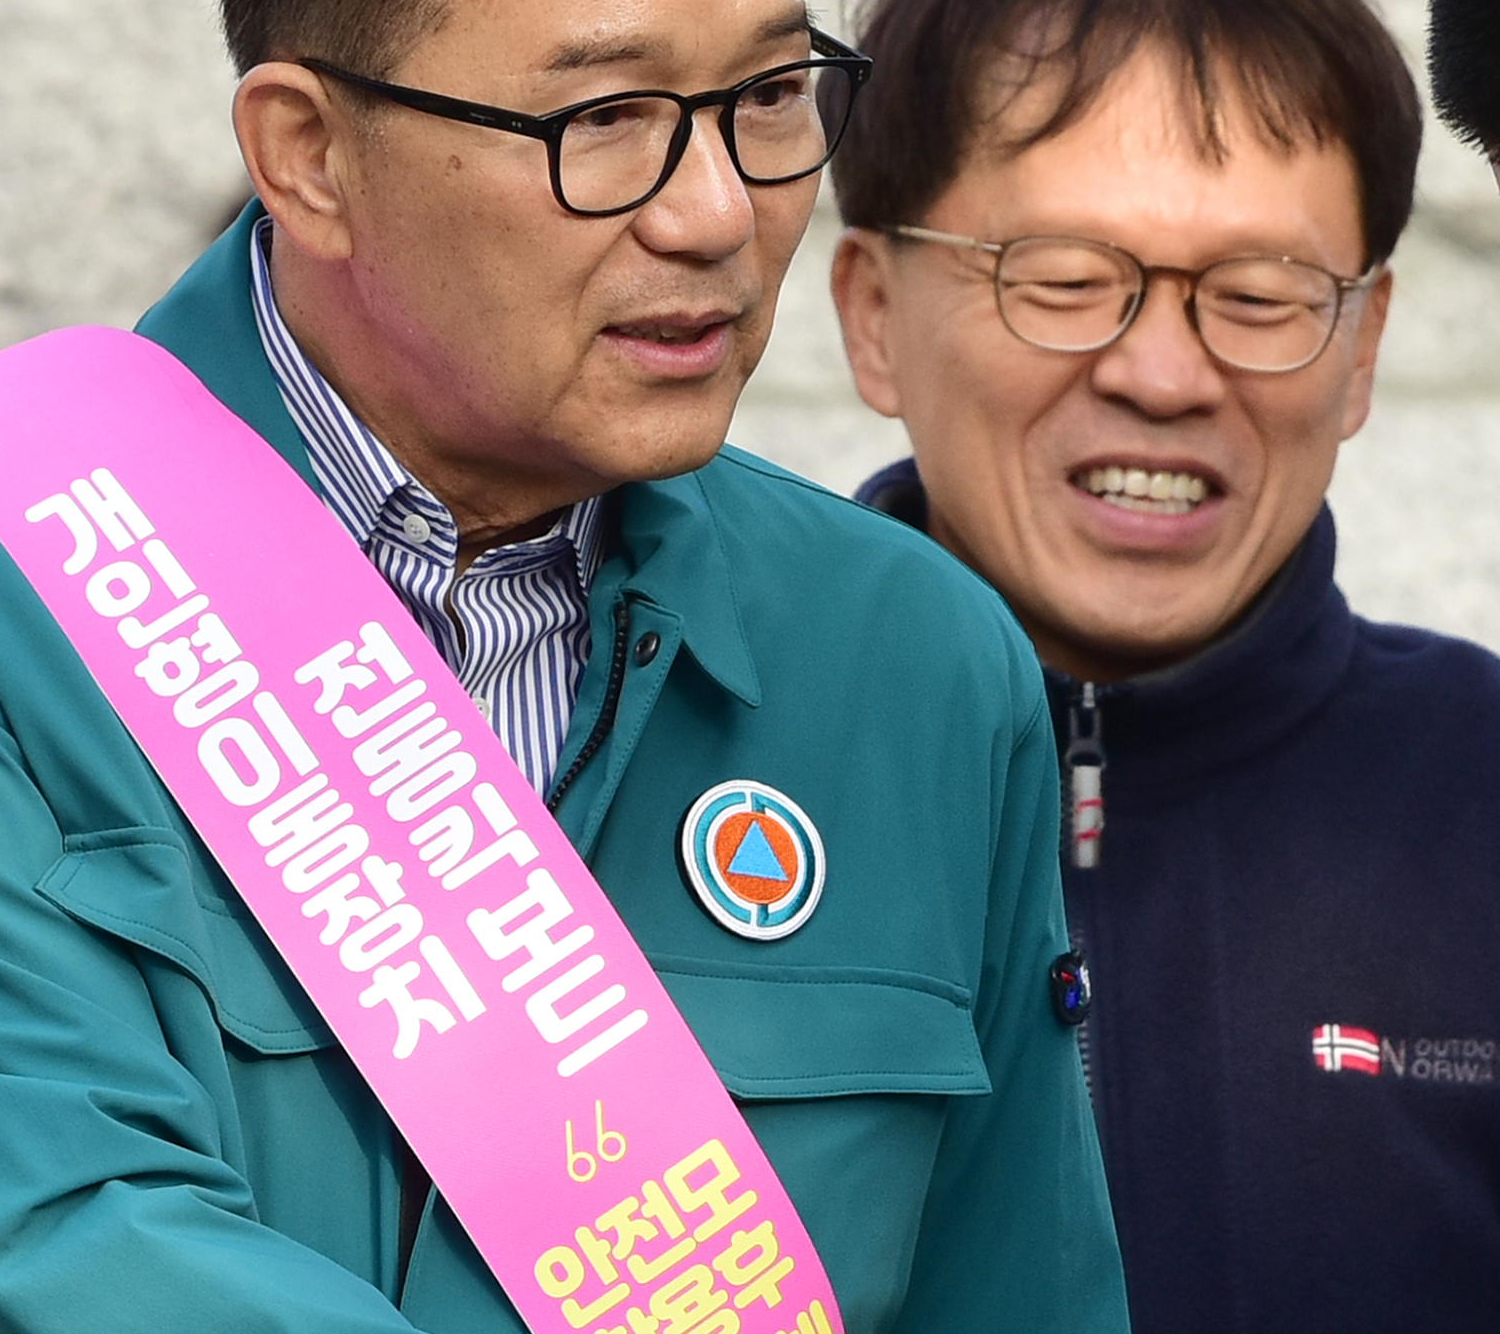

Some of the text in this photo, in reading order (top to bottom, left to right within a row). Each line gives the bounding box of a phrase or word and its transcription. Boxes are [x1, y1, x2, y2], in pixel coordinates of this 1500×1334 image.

[23, 467, 489, 1061] 개인형이동장치
[295, 620, 649, 1077] 전동킥보드
[533, 1137, 760, 1327] 안전모
